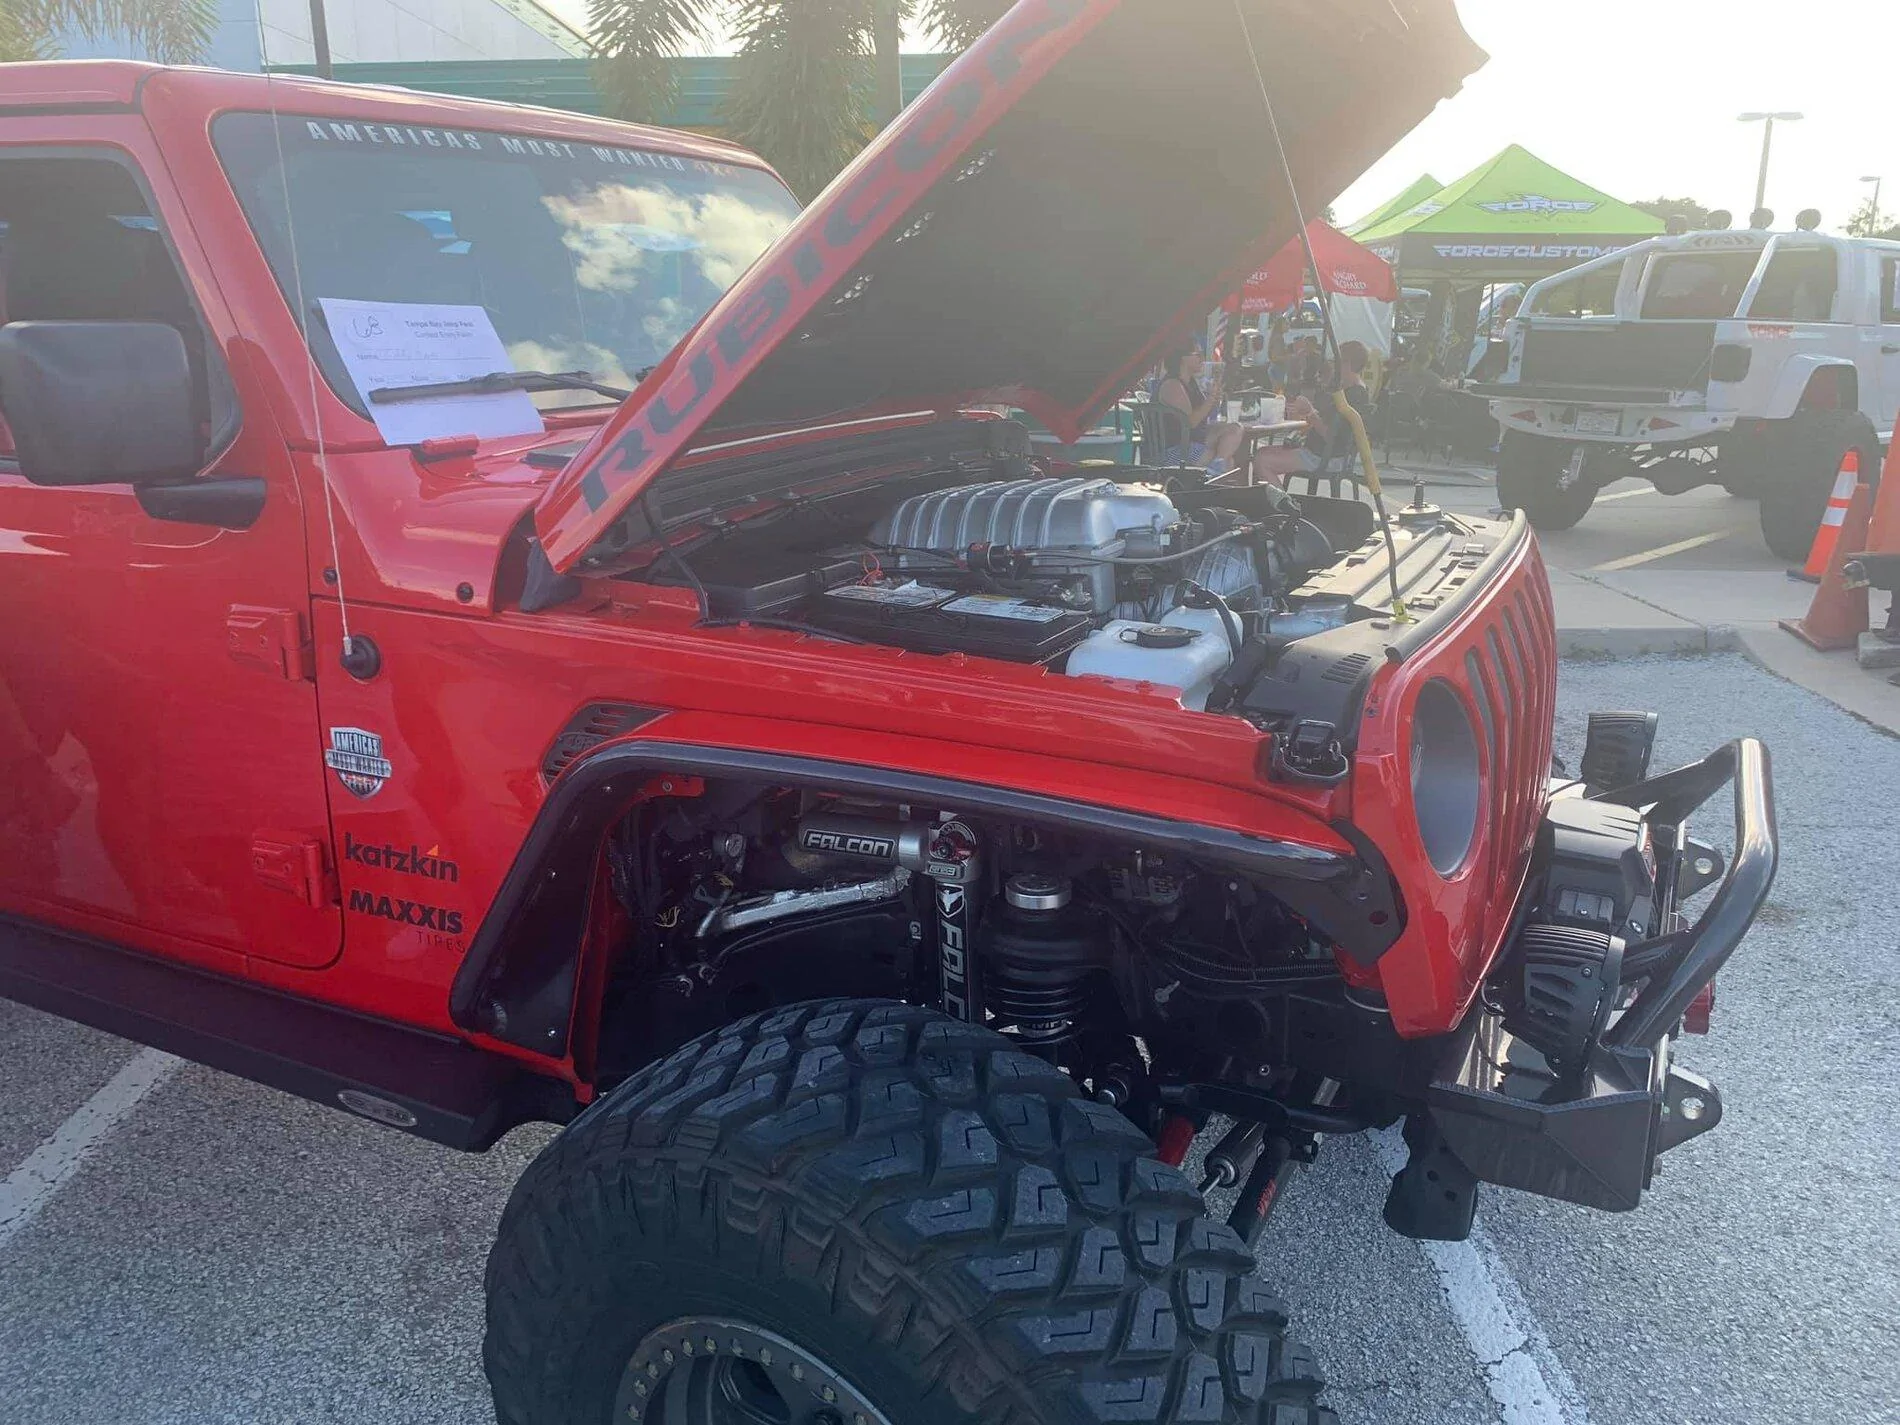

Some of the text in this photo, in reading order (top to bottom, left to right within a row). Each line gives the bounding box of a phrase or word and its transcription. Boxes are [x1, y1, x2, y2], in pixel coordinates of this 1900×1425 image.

[306, 121, 481, 150] AMERICAS
[500, 137, 576, 159] MOST
[592, 147, 685, 171] WANTED
[581, 0, 1089, 513] RUBICON
[345, 832, 458, 882] katzkin
[806, 833, 889, 856] FALCON
[349, 889, 463, 934] MAXXIS
